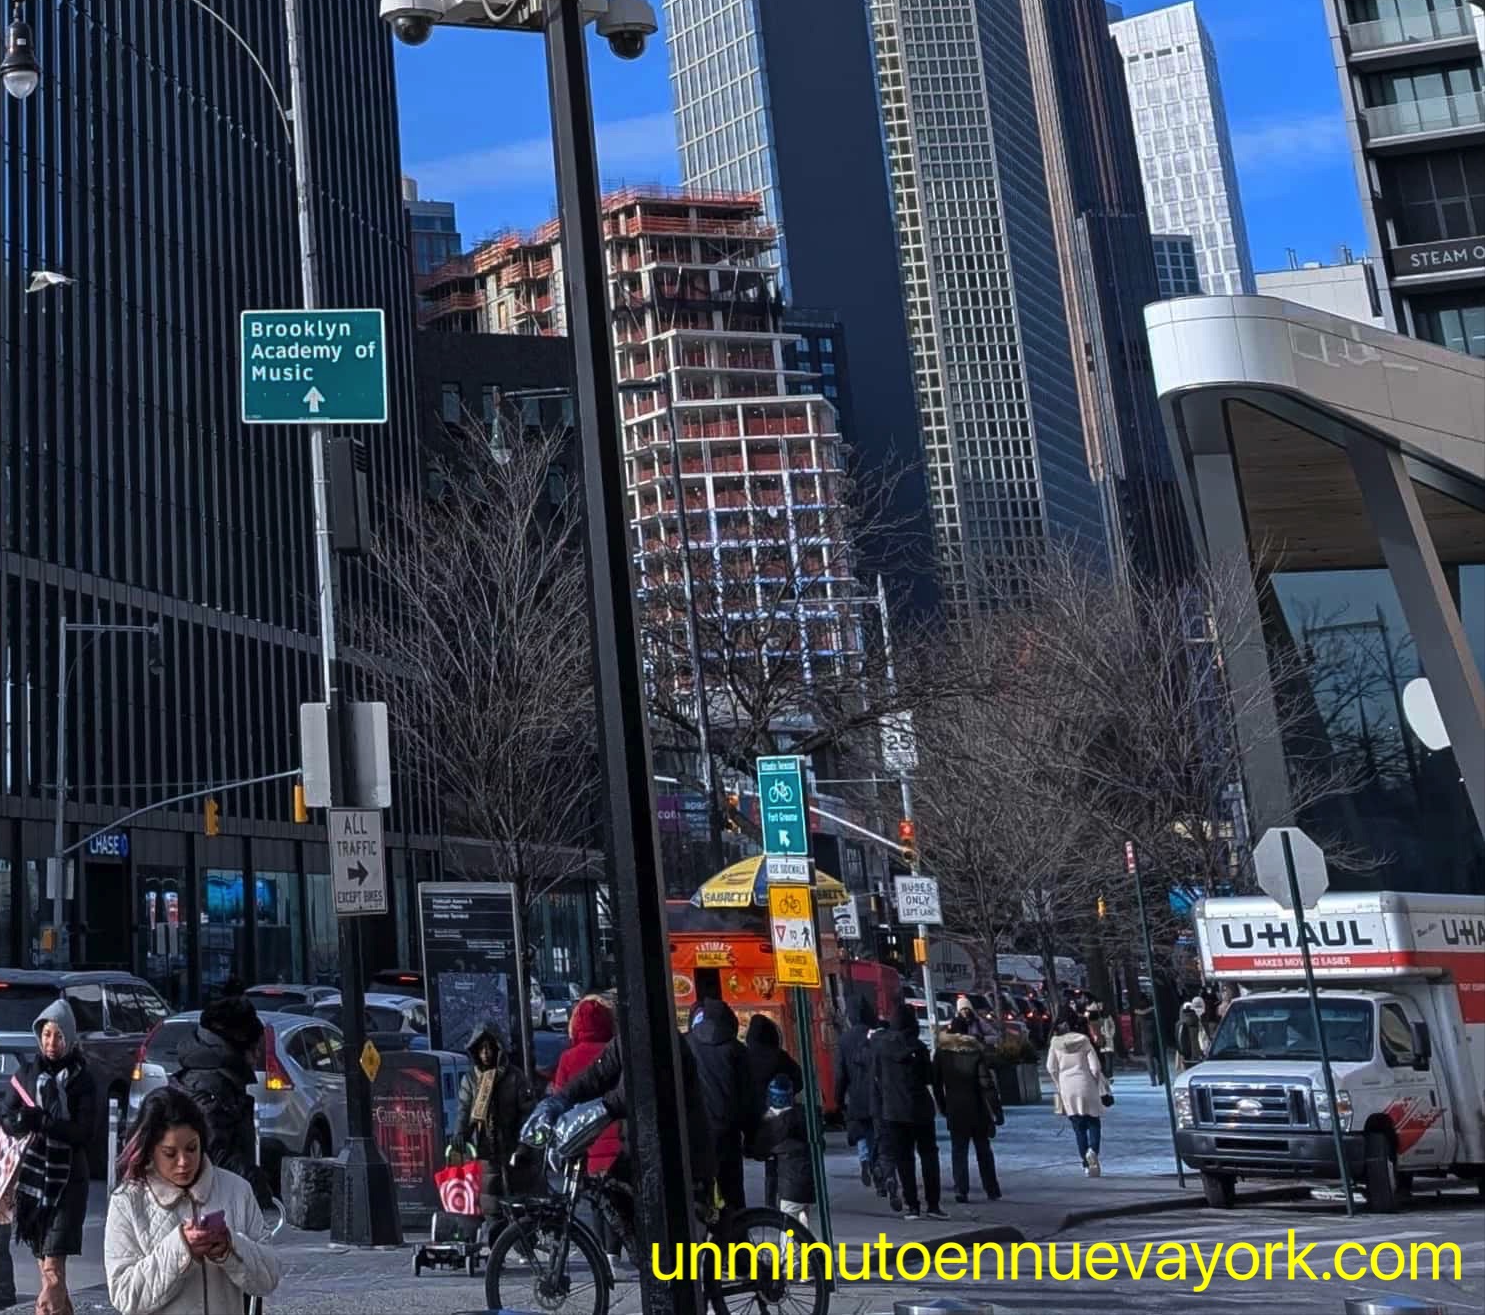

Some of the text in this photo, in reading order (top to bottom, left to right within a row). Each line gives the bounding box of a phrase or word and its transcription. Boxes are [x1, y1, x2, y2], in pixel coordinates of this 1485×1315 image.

[1410, 249, 1468, 267] STEAM
[250, 320, 352, 341] Brooklyn
[250, 341, 376, 363] Academy of
[251, 364, 314, 382] Music
[887, 734, 911, 752] 25
[344, 813, 368, 835] ALL
[90, 833, 120, 855] CHASE
[336, 840, 377, 857] TRAFFIC
[901, 882, 932, 892] BUSES
[337, 891, 362, 904] EXCEPT
[704, 891, 750, 903] SABRETT
[905, 895, 930, 906] ONLY
[1221, 919, 1374, 949] U-HAUL
[1253, 955, 1352, 967] MAKES MOVG EASIER
